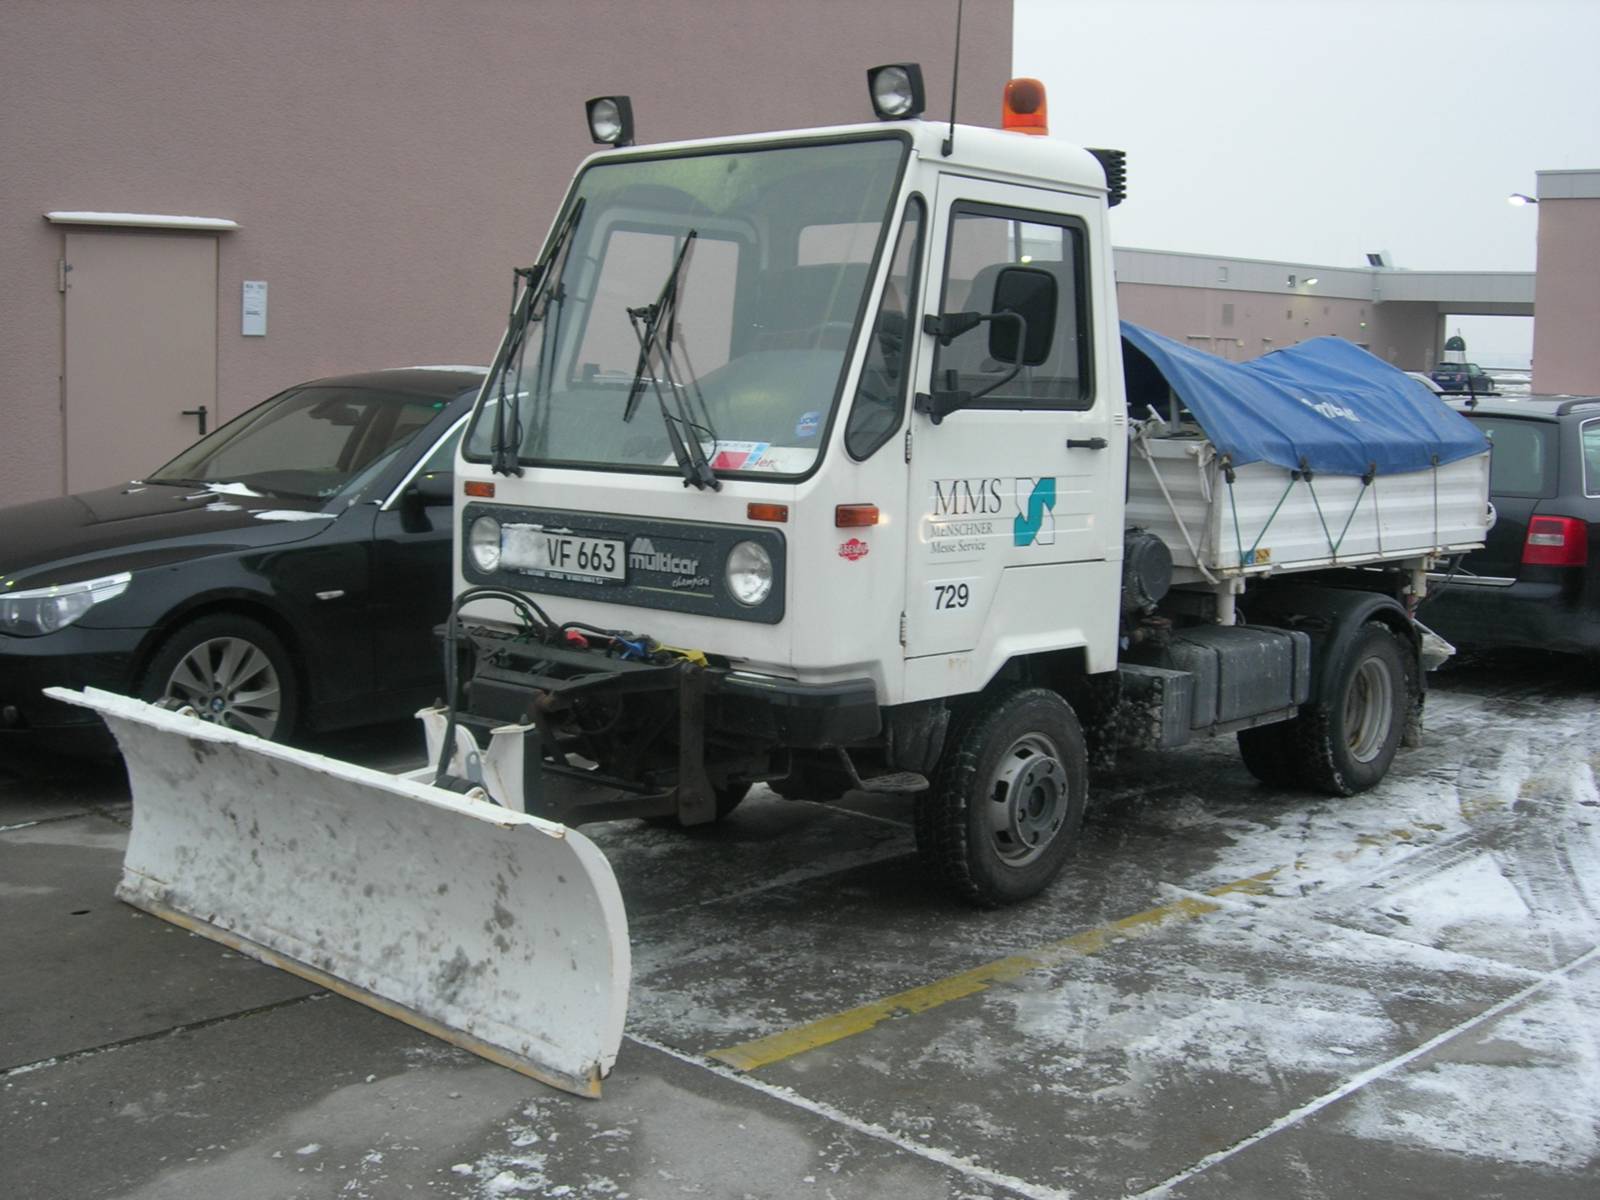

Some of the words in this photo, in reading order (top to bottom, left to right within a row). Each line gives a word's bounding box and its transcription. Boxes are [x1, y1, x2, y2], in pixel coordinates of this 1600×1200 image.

[934, 478, 1002, 516] MMS
[546, 537, 572, 568] VF
[577, 541, 616, 573] 663
[930, 541, 956, 554] Messe
[957, 538, 987, 552] Service
[629, 549, 699, 576] multicar
[934, 583, 970, 610] 729
